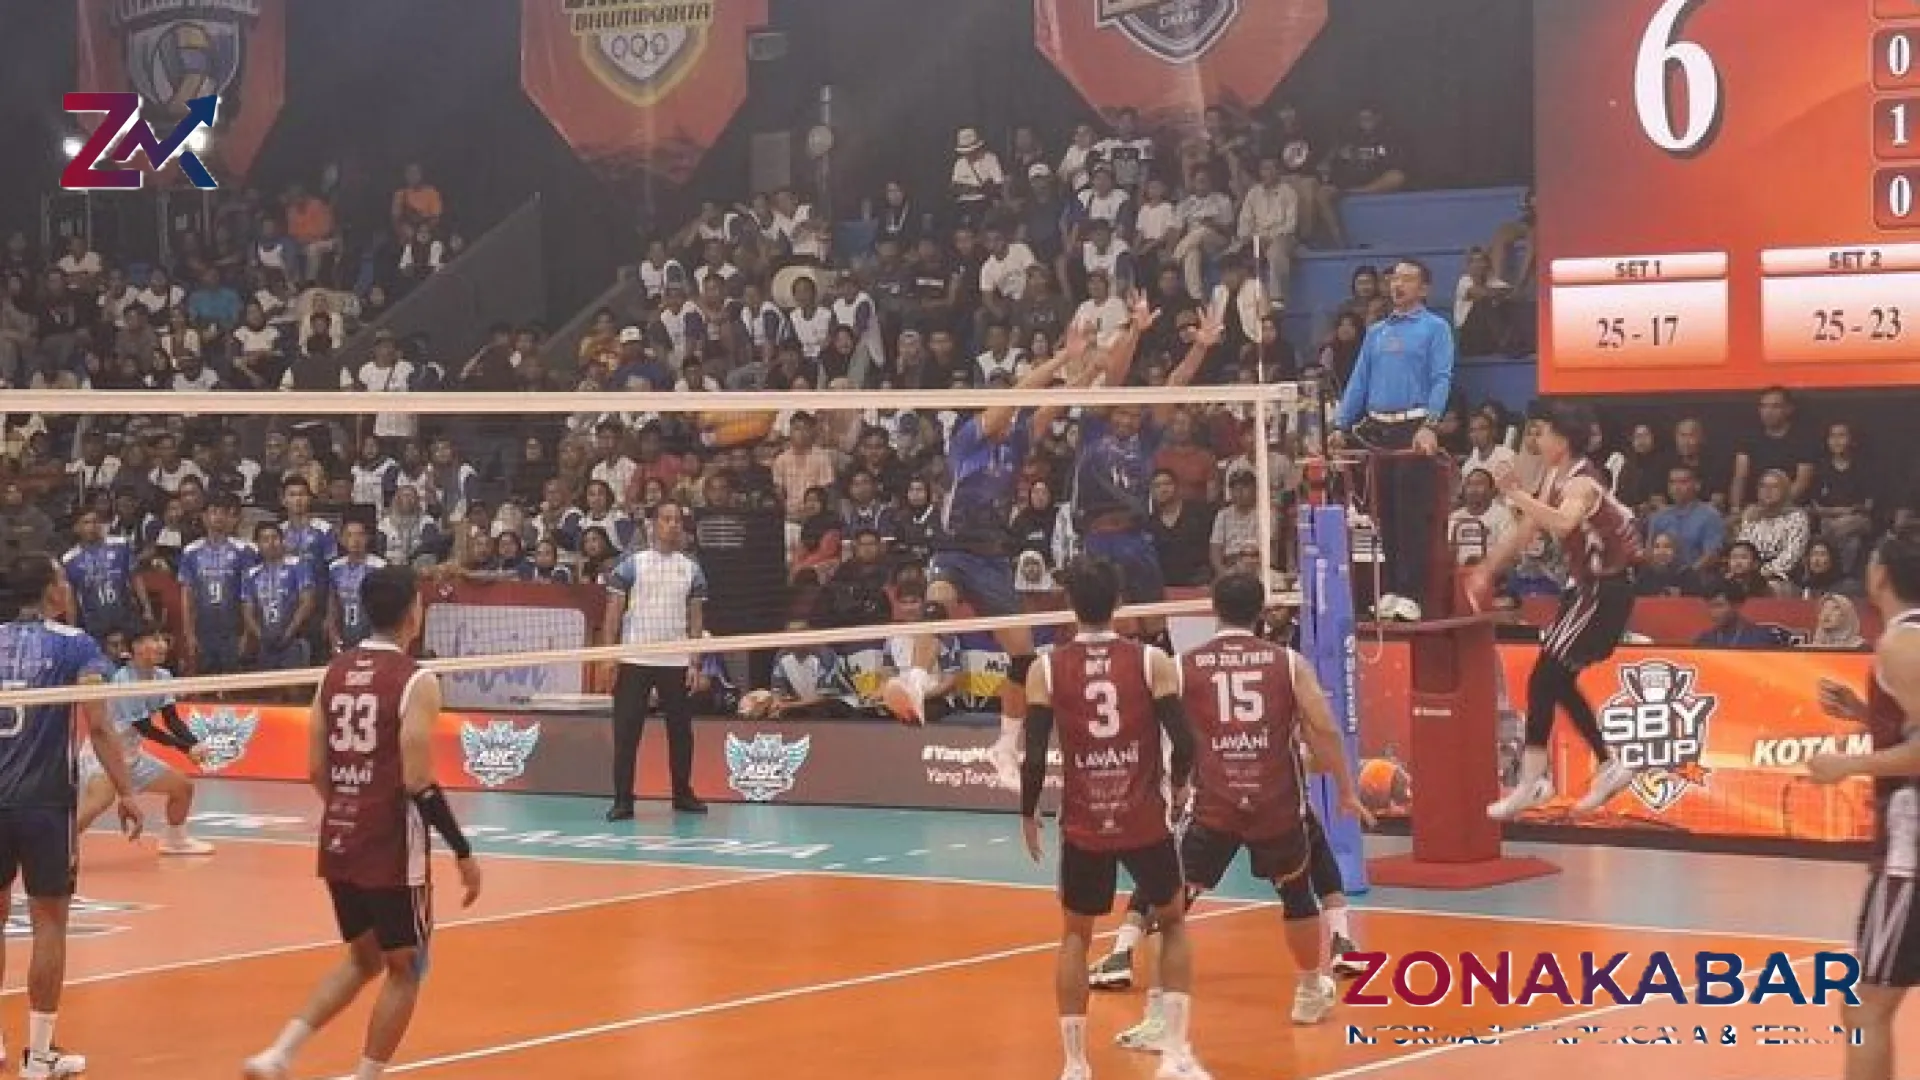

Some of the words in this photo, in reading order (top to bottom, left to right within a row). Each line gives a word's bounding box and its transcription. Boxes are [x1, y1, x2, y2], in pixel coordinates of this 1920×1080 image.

[1635, 0, 1718, 149] 6
[1888, 35, 1910, 75] 0
[1889, 104, 1910, 146] 1
[1889, 175, 1912, 217] 0
[1615, 260, 1650, 278] SET
[1829, 252, 1866, 270] SET
[1870, 250, 1882, 268] 2
[1597, 318, 1625, 349] 25
[1650, 315, 1679, 345] 17
[1813, 310, 1844, 341] 25
[1869, 307, 1902, 340] 23
[208, 580, 222, 604] 9
[1085, 681, 1120, 738] 3
[1210, 671, 1265, 722] 15
[328, 694, 378, 752] 33
[1602, 699, 1707, 741] SBY
[1619, 740, 1700, 767] CUP
[1753, 736, 1838, 766] KOTA
